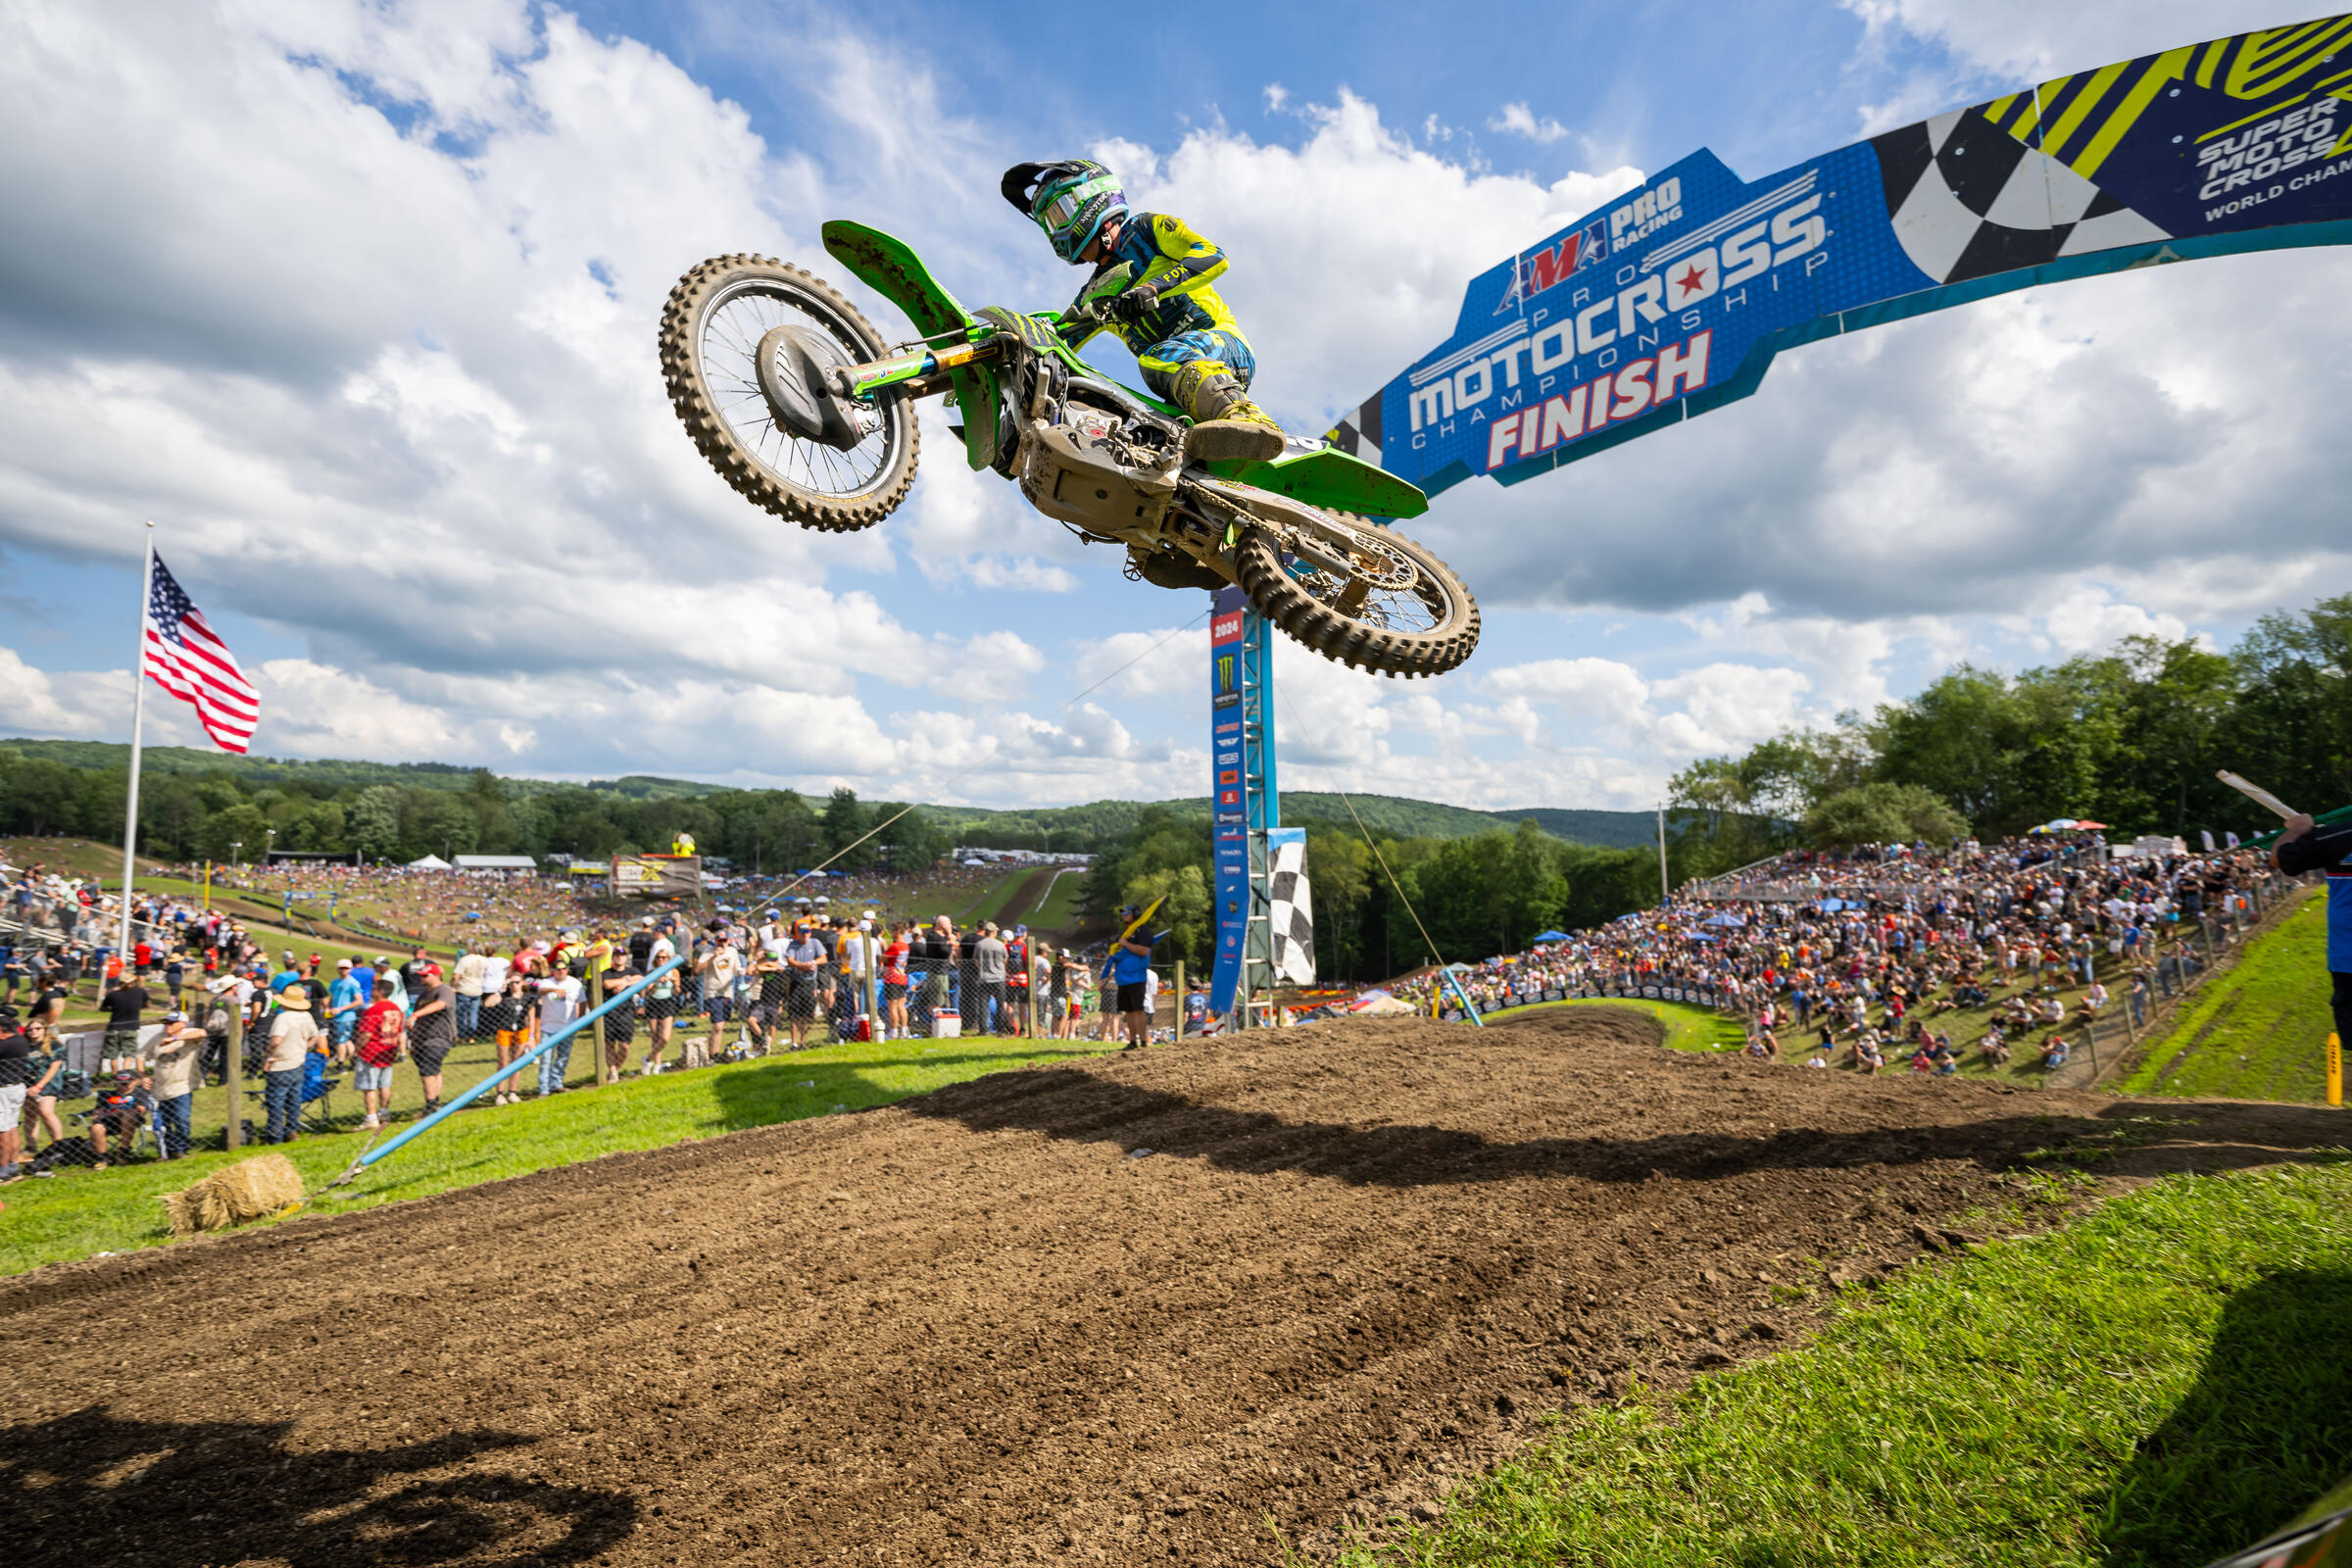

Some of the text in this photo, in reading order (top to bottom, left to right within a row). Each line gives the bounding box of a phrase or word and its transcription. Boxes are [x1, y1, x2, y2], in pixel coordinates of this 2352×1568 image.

[2195, 97, 2340, 168] SUPER
[2207, 118, 2334, 181] MOTO
[2198, 134, 2339, 201] CROSS
[1610, 176, 1681, 239] PRO
[1612, 205, 1684, 254] RACING
[2205, 185, 2284, 222] WORLD
[1162, 264, 1189, 282] FOX
[1492, 217, 1608, 317] AMA
[1532, 265, 1636, 328] PRO
[1409, 192, 1827, 433] MOTOCROSS
[1411, 252, 1829, 451] CHAMPIONSHIP
[1486, 328, 1713, 471] FINISH
[1214, 619, 1239, 638] 2024
